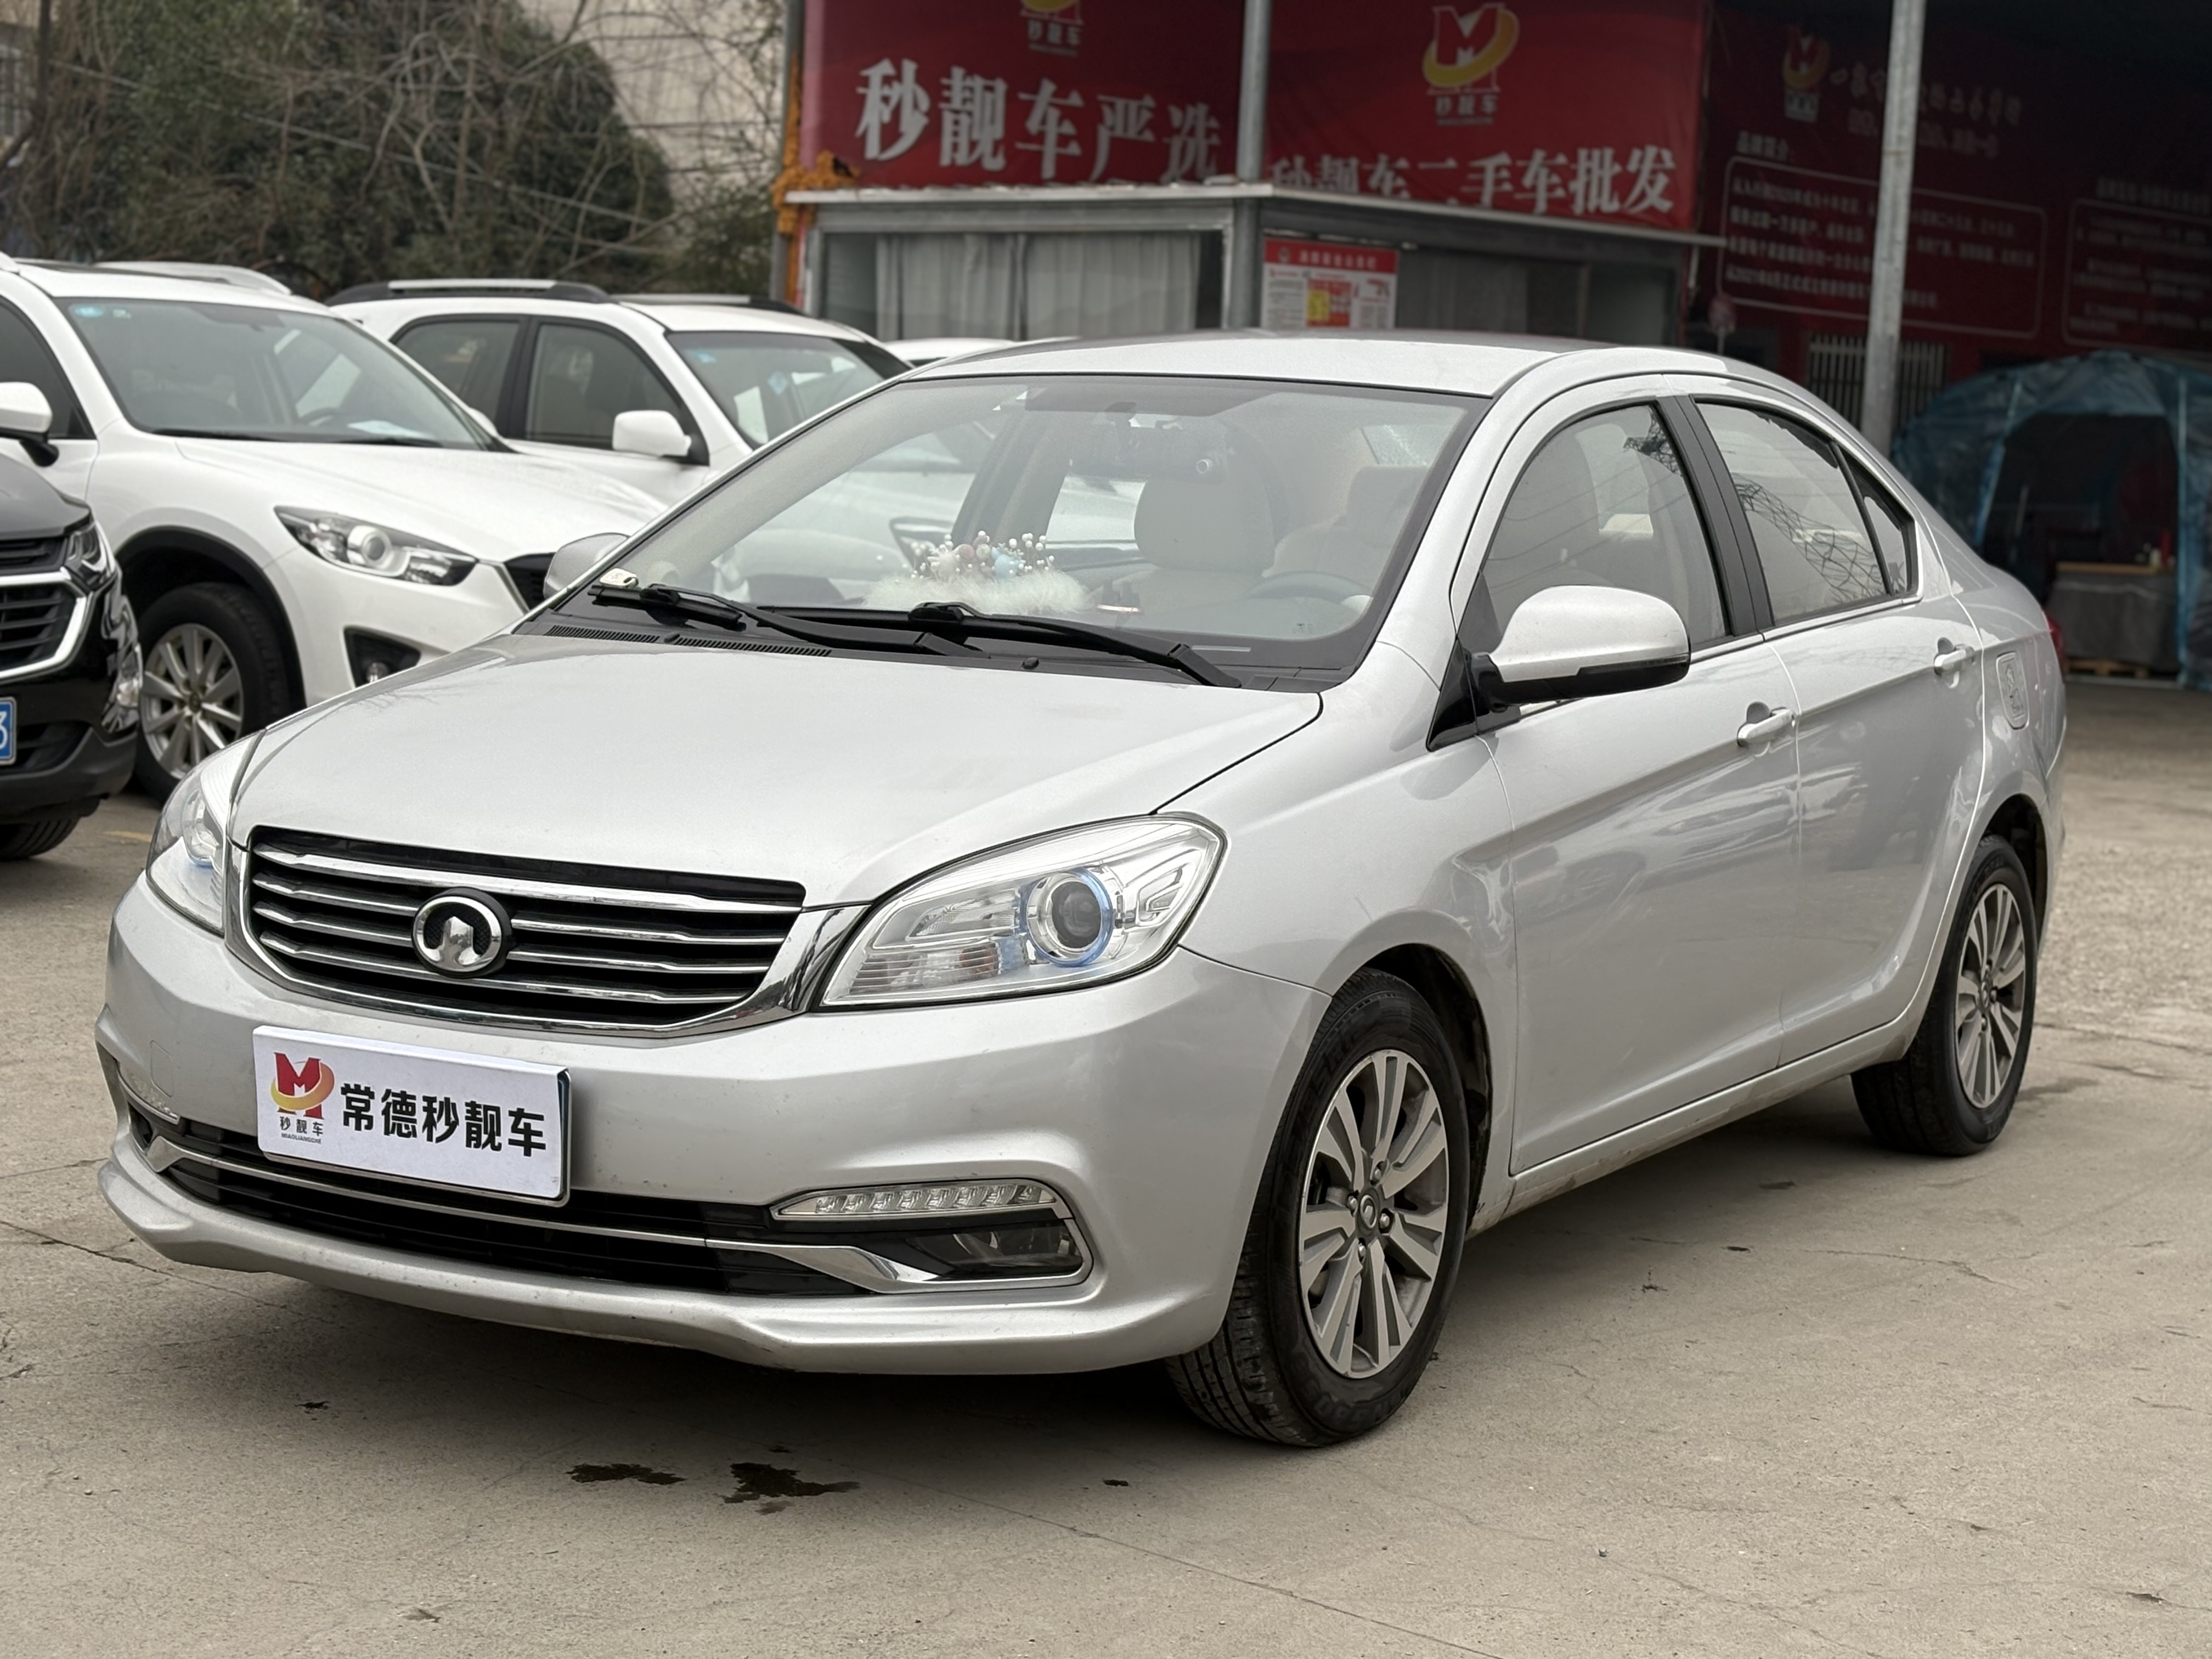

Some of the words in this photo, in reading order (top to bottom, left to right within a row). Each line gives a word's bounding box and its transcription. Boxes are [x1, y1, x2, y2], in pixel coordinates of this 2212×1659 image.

[856, 58, 1221, 184] 秒靓车严选
[279, 1116, 324, 1136] 秒靓车
[340, 1082, 547, 1158] 常德秒靓车
